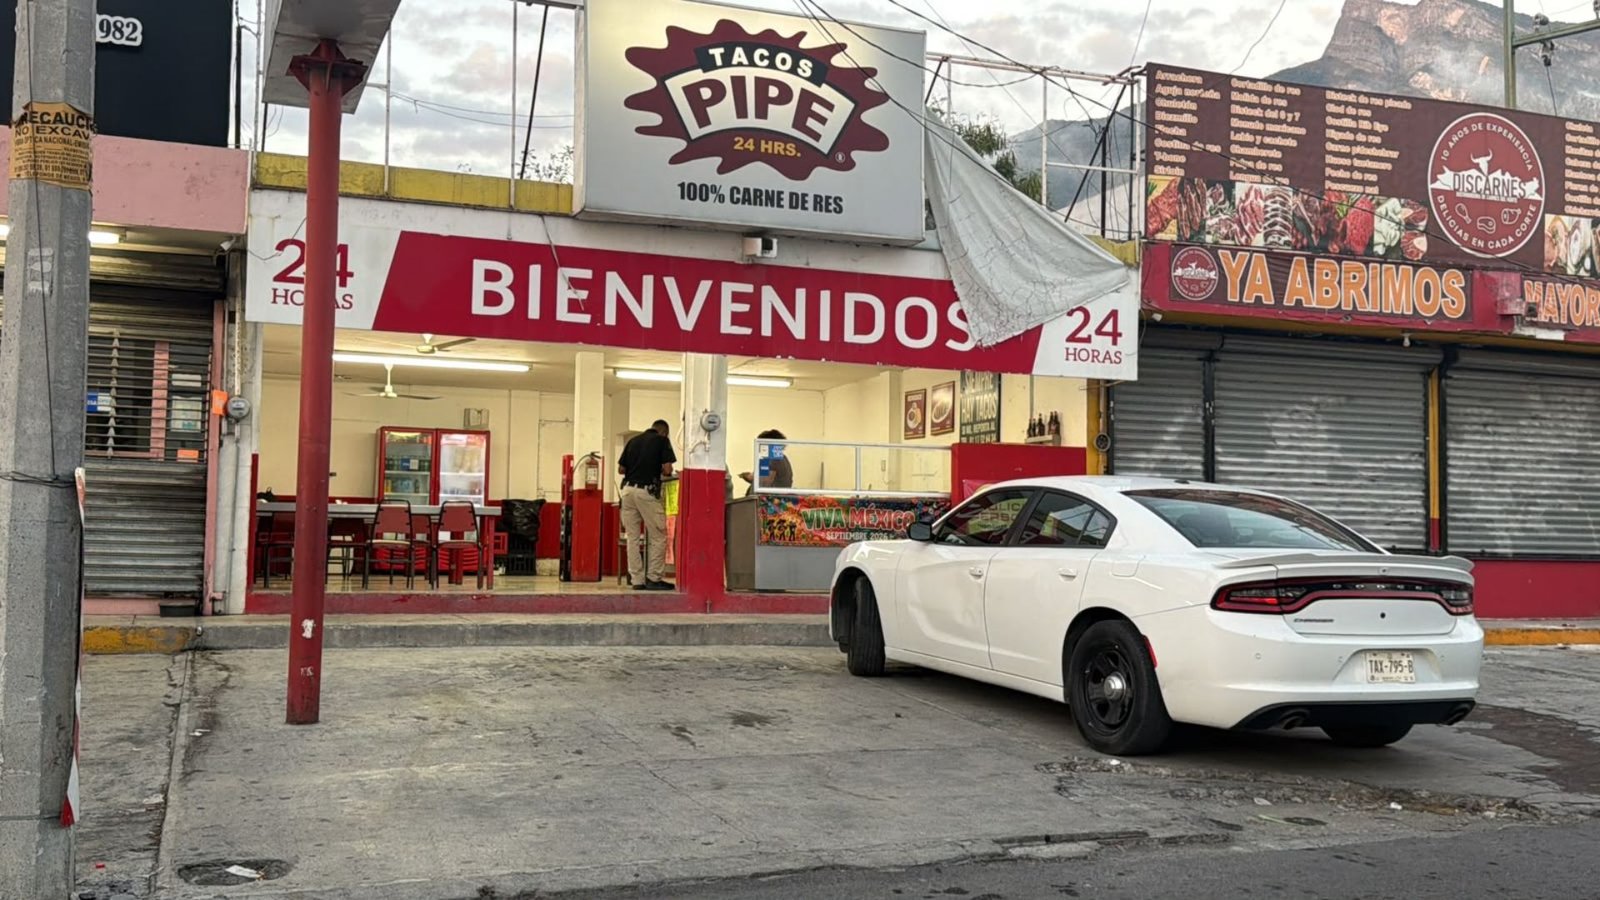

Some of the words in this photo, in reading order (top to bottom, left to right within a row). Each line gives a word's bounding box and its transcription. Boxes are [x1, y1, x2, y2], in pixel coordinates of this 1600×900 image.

[709, 47, 813, 77] TACOS
[1261, 95, 1272, 105] de
[1273, 98, 1288, 107] res
[1274, 84, 1286, 94] de
[1287, 86, 1301, 96] res
[682, 75, 835, 143] PIPE
[15, 125, 29, 137] NO
[733, 137, 755, 151] 24
[760, 140, 801, 156] HRS.
[1441, 150, 1450, 161] 10
[1449, 126, 1469, 148] AÑOS
[1472, 122, 1483, 131] DE
[1486, 123, 1533, 171] EXPERIENCIA
[677, 182, 725, 204] 100%
[729, 186, 785, 208] CARNE
[788, 191, 808, 211] DE
[812, 194, 843, 215] RES
[1453, 173, 1526, 199] DISCARNES
[1437, 195, 1469, 241] DELICIAS
[1471, 237, 1484, 249] EN
[1487, 235, 1514, 249] CADA
[1515, 204, 1537, 238] CORTE
[273, 238, 354, 288] 24
[271, 288, 354, 310] HOAS
[1218, 250, 1274, 305] YA
[1283, 256, 1466, 319] ABRIMOS
[470, 258, 976, 352] BIENVENIDOS
[1065, 305, 1122, 347] 24
[1065, 347, 1122, 365] HORAS
[976, 392, 998, 421] TACOS
[802, 507, 846, 531] VIVA
[849, 503, 915, 531] MÉXICO
[826, 531, 868, 541] SEPTIEMBRE
